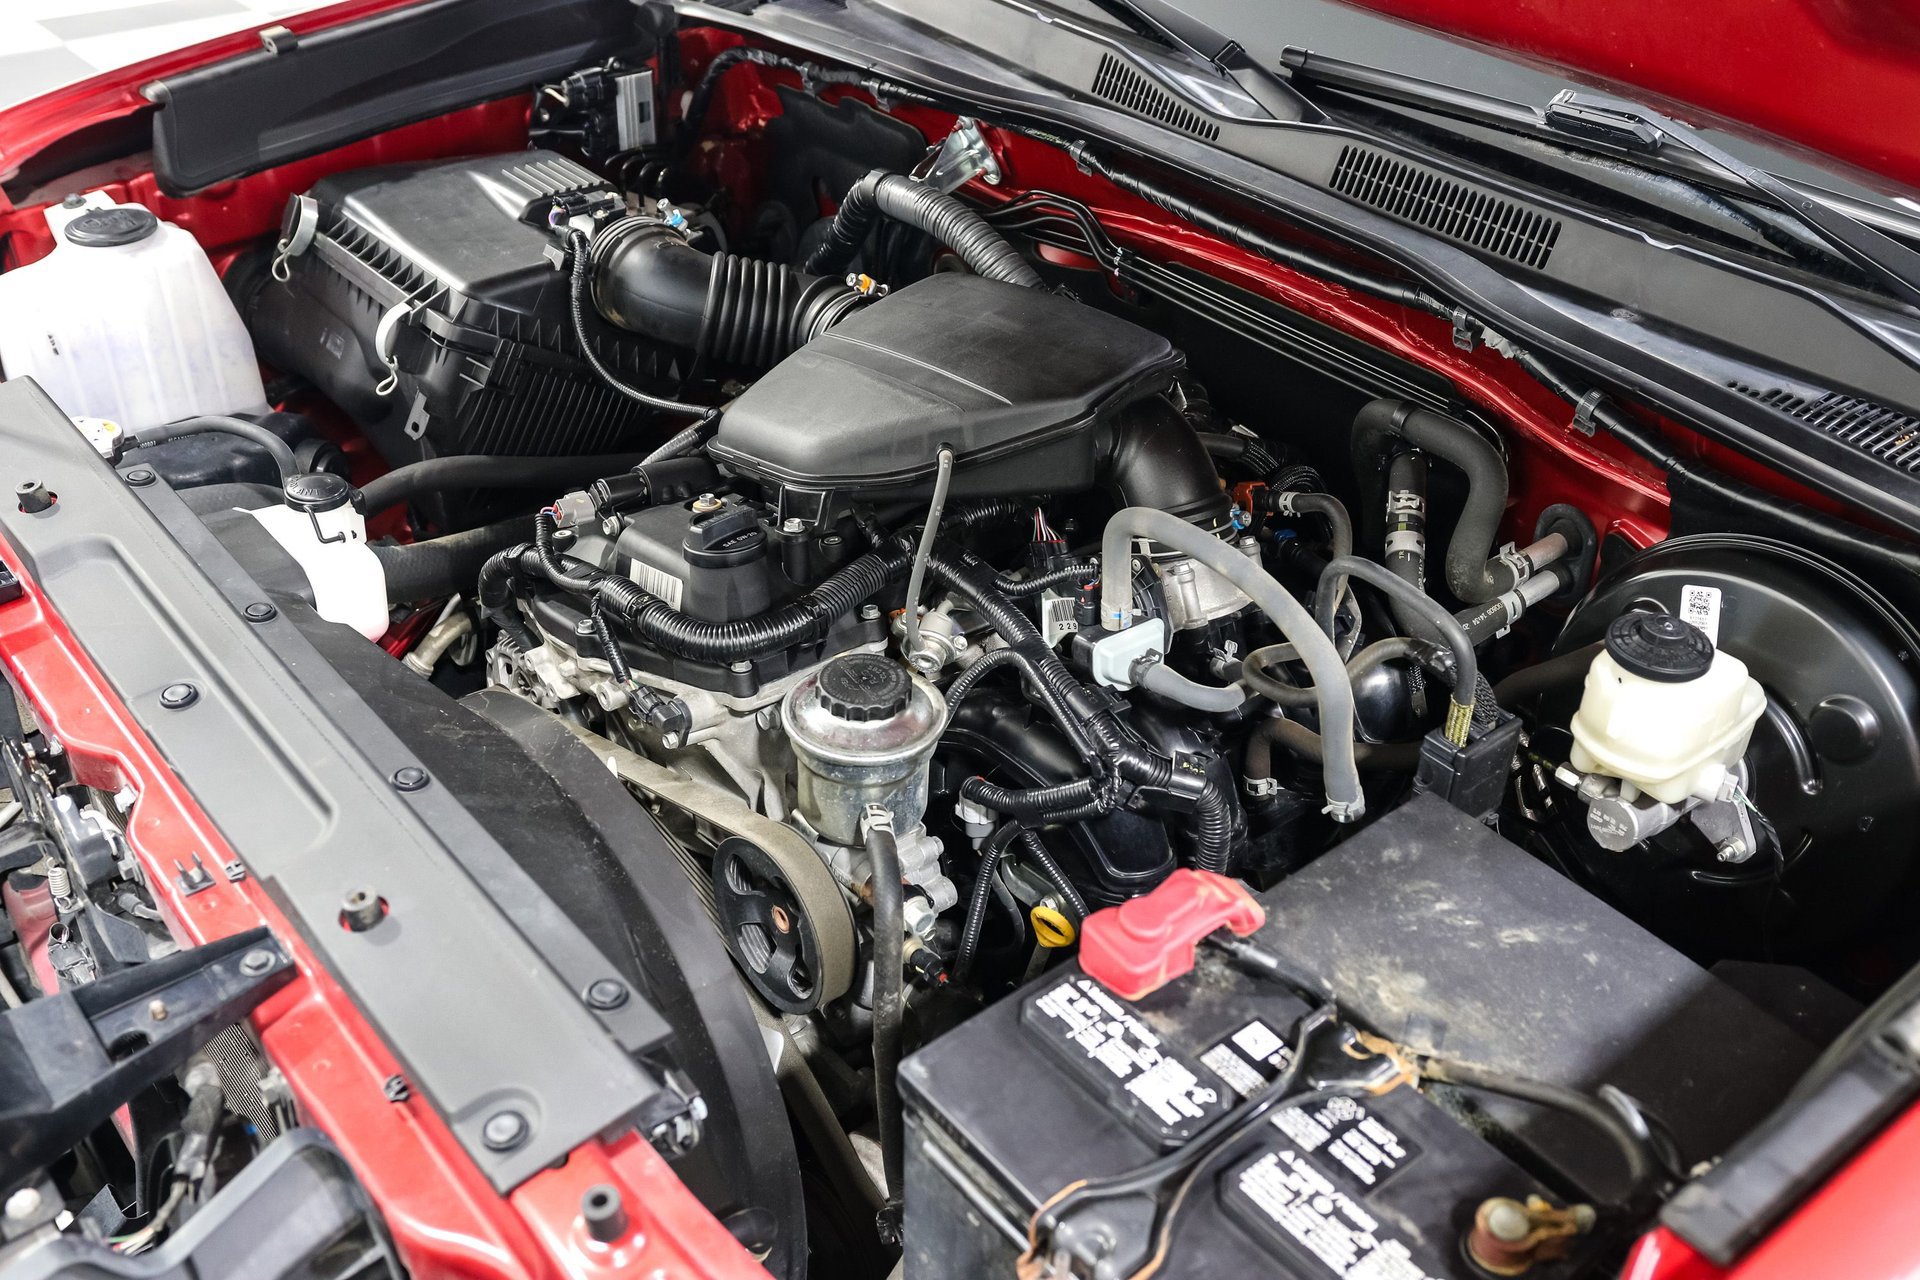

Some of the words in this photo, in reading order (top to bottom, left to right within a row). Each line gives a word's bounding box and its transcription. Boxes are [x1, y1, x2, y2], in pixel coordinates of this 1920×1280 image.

[722, 539, 737, 548] SAE
[736, 531, 758, 541] 0W-20
[1058, 622, 1077, 631] 229
